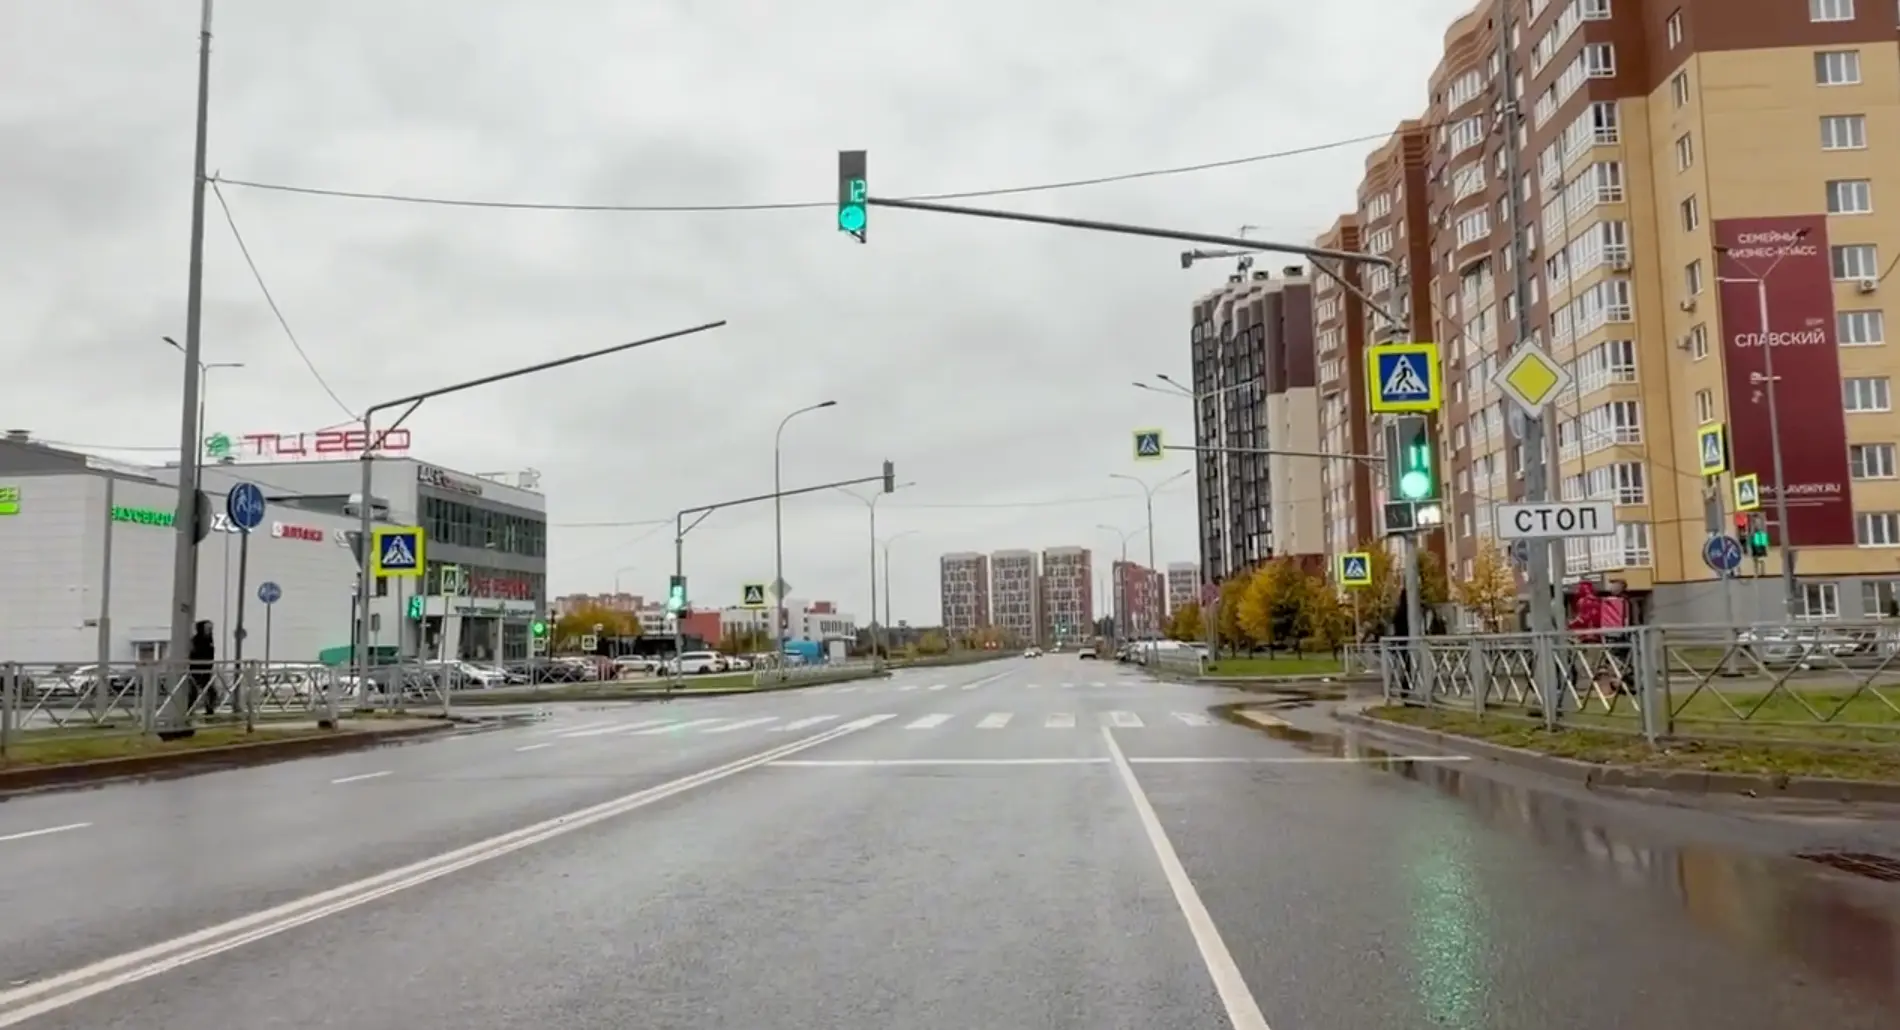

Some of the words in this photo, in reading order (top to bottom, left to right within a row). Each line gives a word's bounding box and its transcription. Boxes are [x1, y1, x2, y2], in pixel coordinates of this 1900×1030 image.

[850, 179, 866, 202] 12
[1737, 230, 1805, 244] СЕМЕЙНЫ
[1735, 327, 1826, 348] СЛАВСКИЙ
[244, 433, 307, 456] ТЦ
[1410, 445, 1429, 469] 11
[1515, 507, 1597, 532] СТОП
